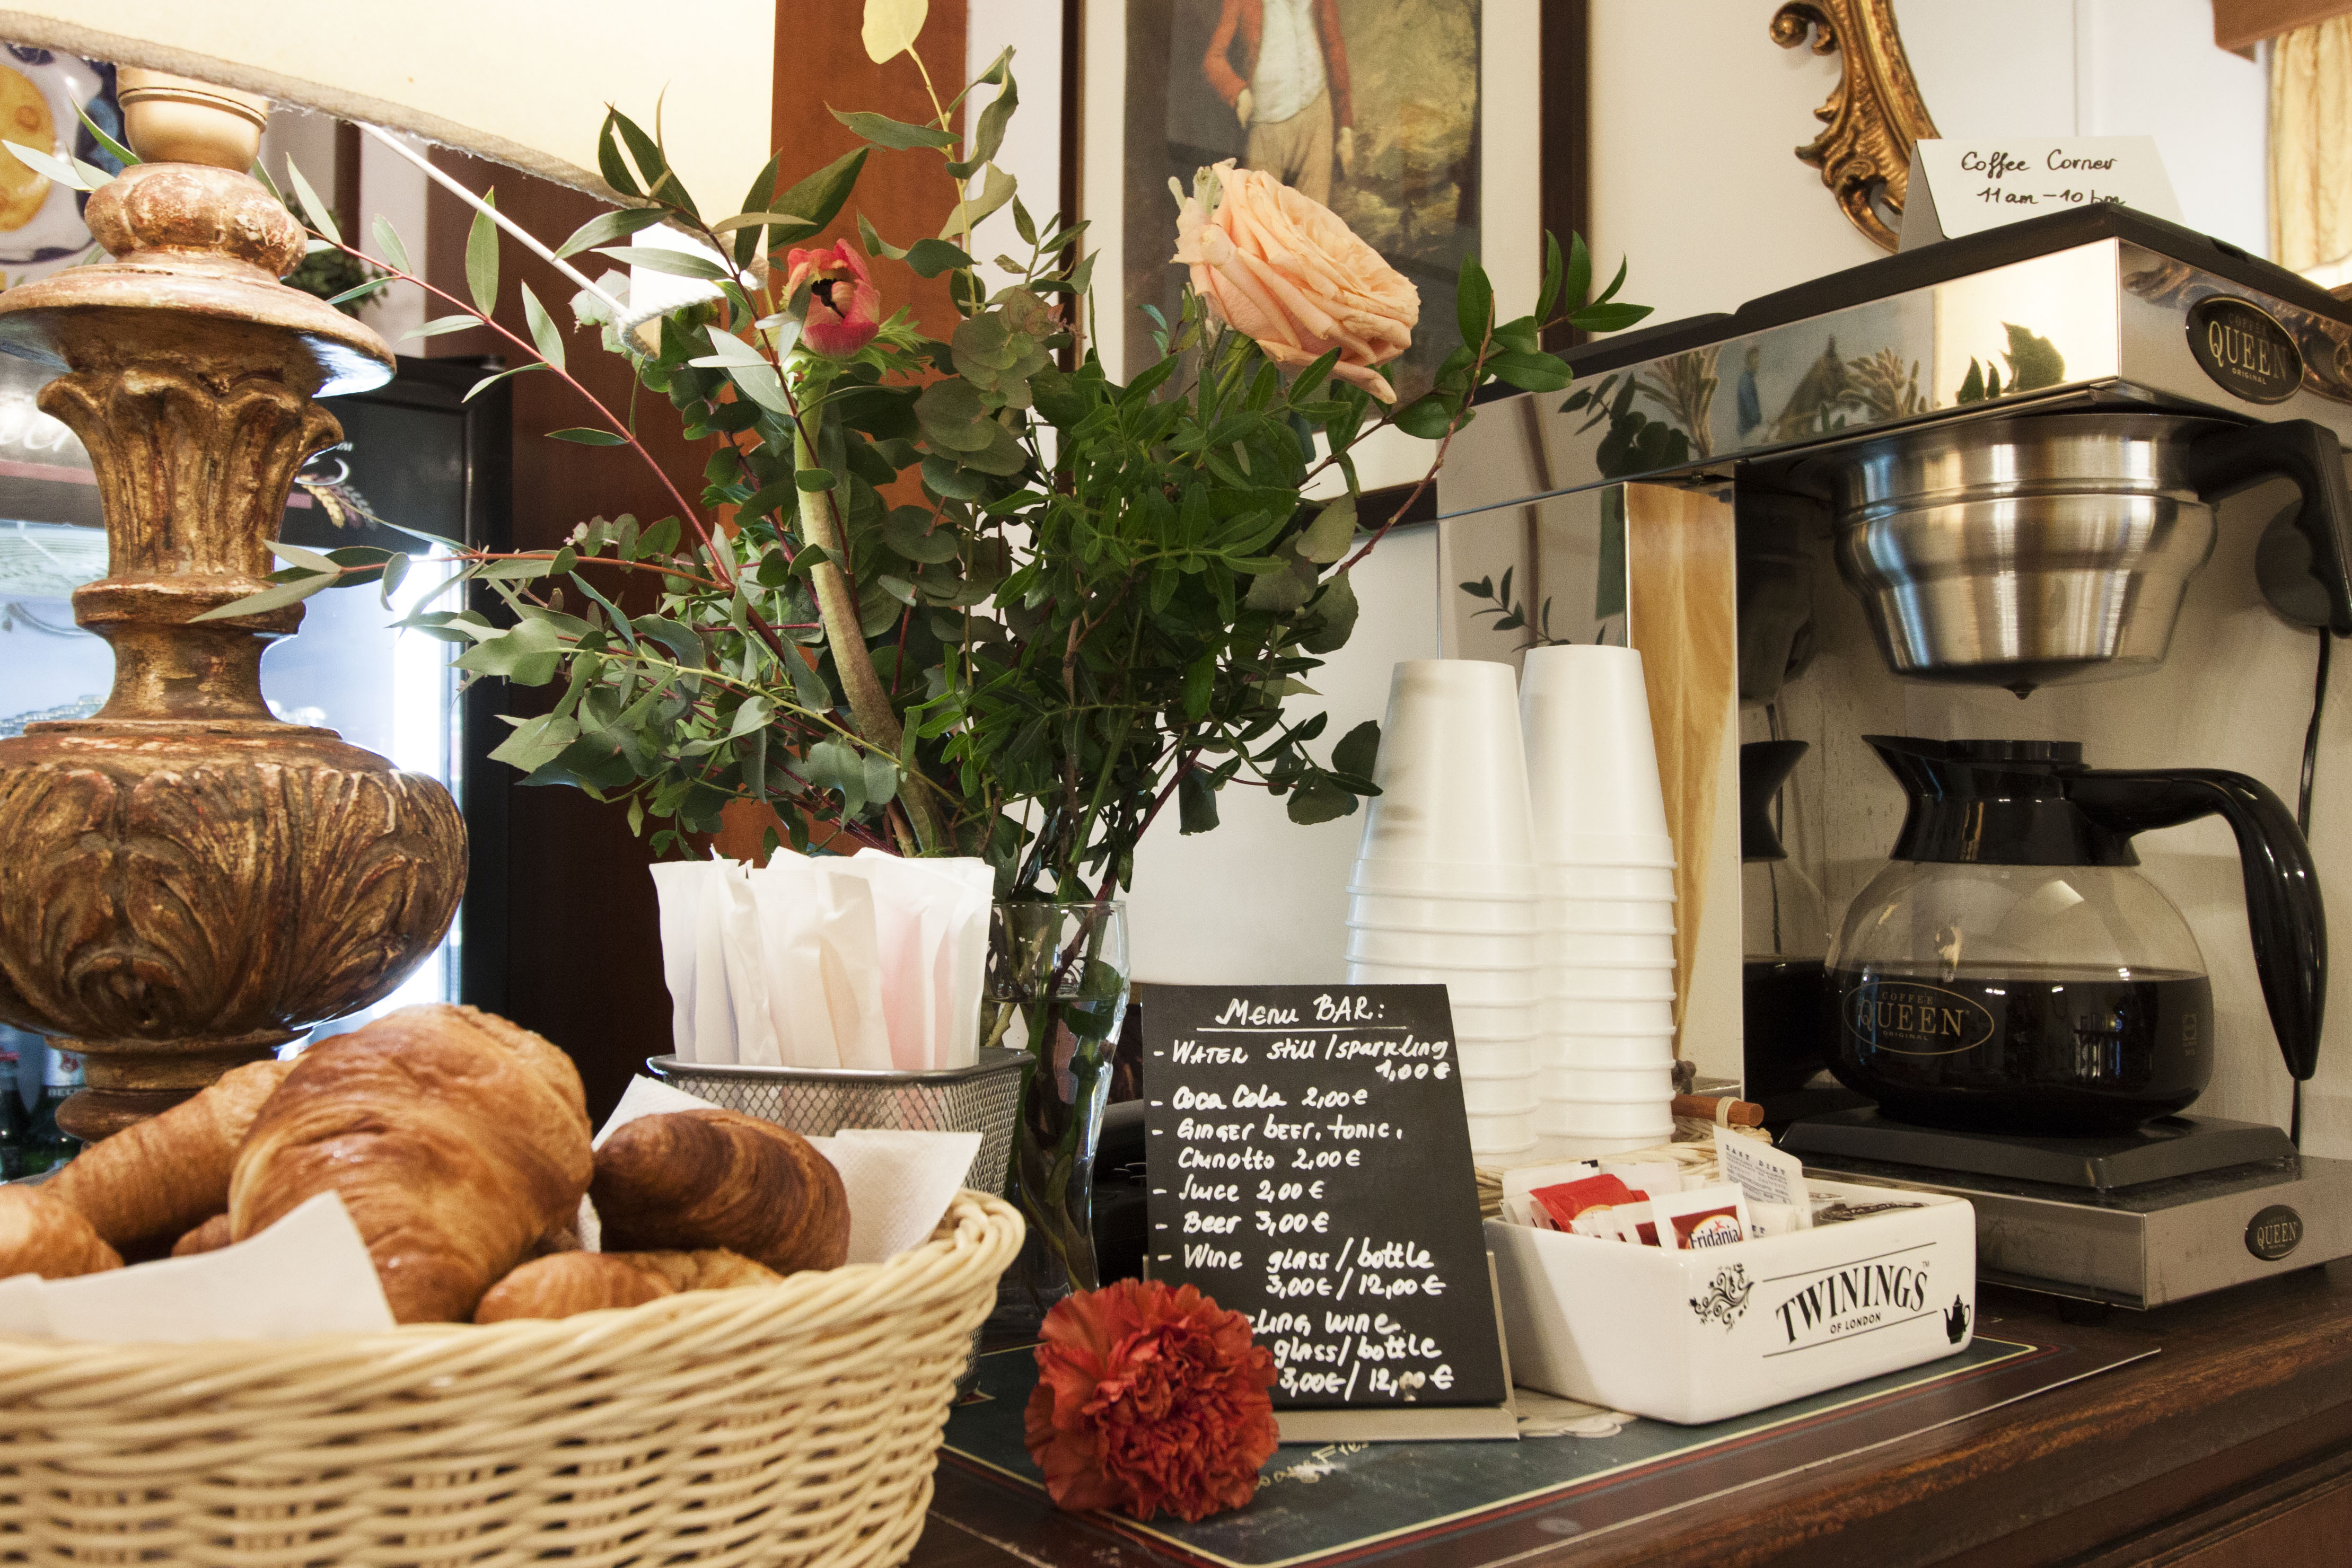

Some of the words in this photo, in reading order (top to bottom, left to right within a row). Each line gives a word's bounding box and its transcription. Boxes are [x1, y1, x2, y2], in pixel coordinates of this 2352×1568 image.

[1961, 151, 2031, 179] Coffee
[2047, 149, 2118, 171] Corner
[2209, 321, 2287, 379] QUEEN
[2232, 367, 2267, 385] ORIGINAL
[1313, 994, 1385, 1024] BAR:
[1882, 992, 1934, 1005] COFFEE
[1883, 1030, 1928, 1041] ORIGINAL
[1173, 1086, 1227, 1111] Coca
[1232, 1085, 1287, 1109] Cola
[1183, 1211, 1242, 1234] Beer
[2257, 1221, 2297, 1250] QUEEN
[1184, 1244, 1243, 1270] Wine
[1775, 1264, 1928, 1344] TWININGS
[1830, 1324, 1842, 1335] OF
[1845, 1312, 1881, 1331] LONDON
